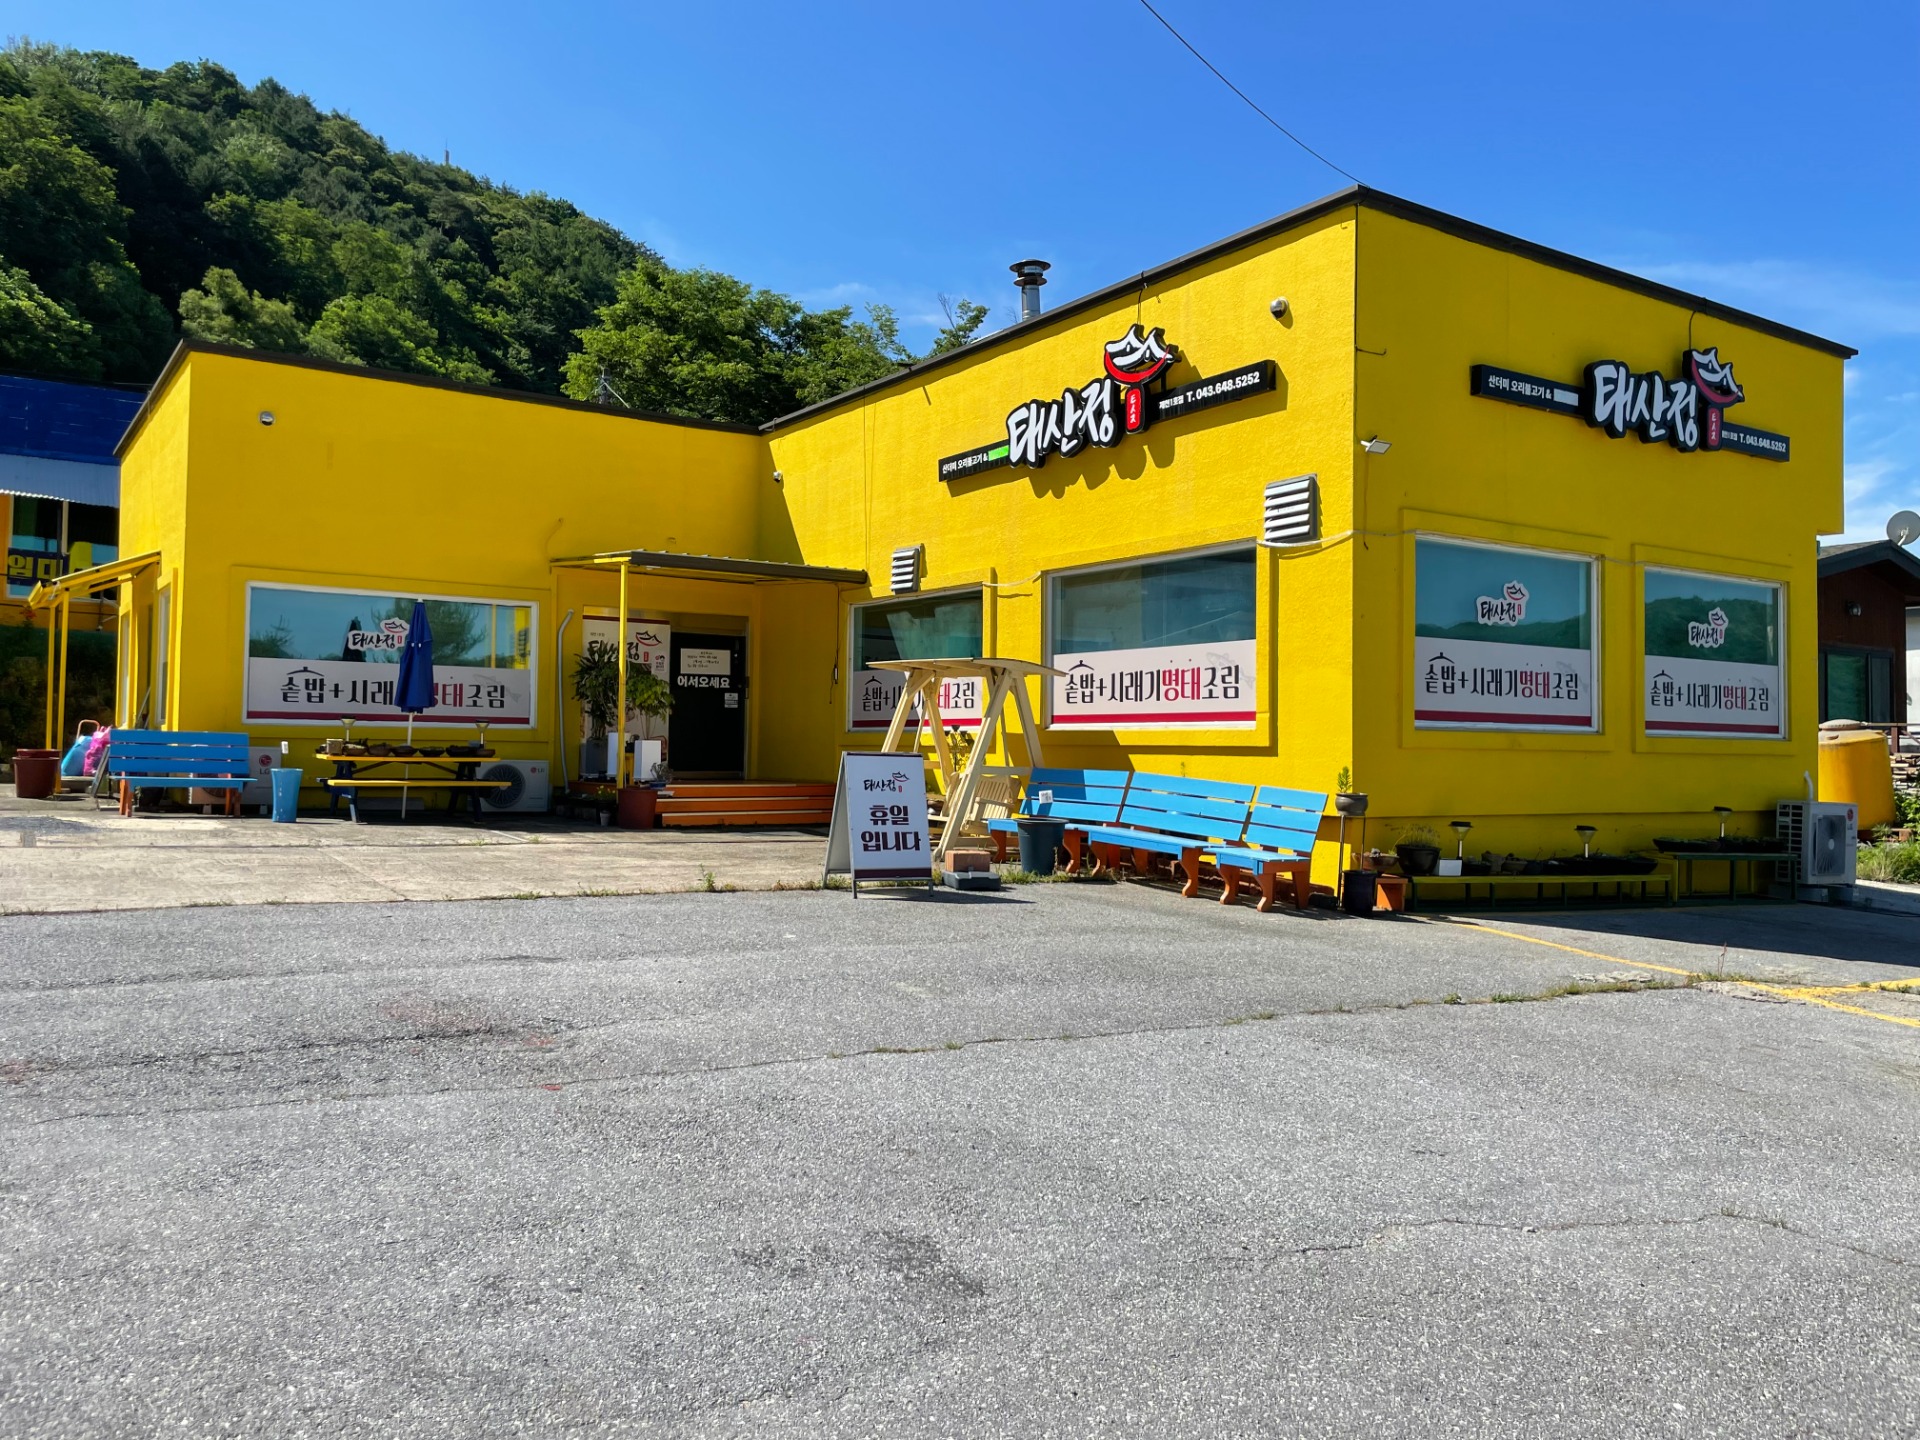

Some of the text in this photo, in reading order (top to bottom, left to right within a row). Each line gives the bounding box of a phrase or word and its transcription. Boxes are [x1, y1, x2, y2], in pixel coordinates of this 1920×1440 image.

[1488, 375, 1510, 391] 산더미
[1511, 381, 1545, 399] 오리불고기
[1594, 364, 1698, 448] 태산정
[1008, 378, 1114, 463] 태산정
[1481, 601, 1516, 622] 태산정
[352, 633, 395, 649] 태산정
[1690, 626, 1719, 646] 태산정
[677, 675, 730, 689] 어서오세요
[863, 779, 896, 792] 태산정
[869, 805, 909, 826] 휴일
[861, 831, 921, 852] 입니다
